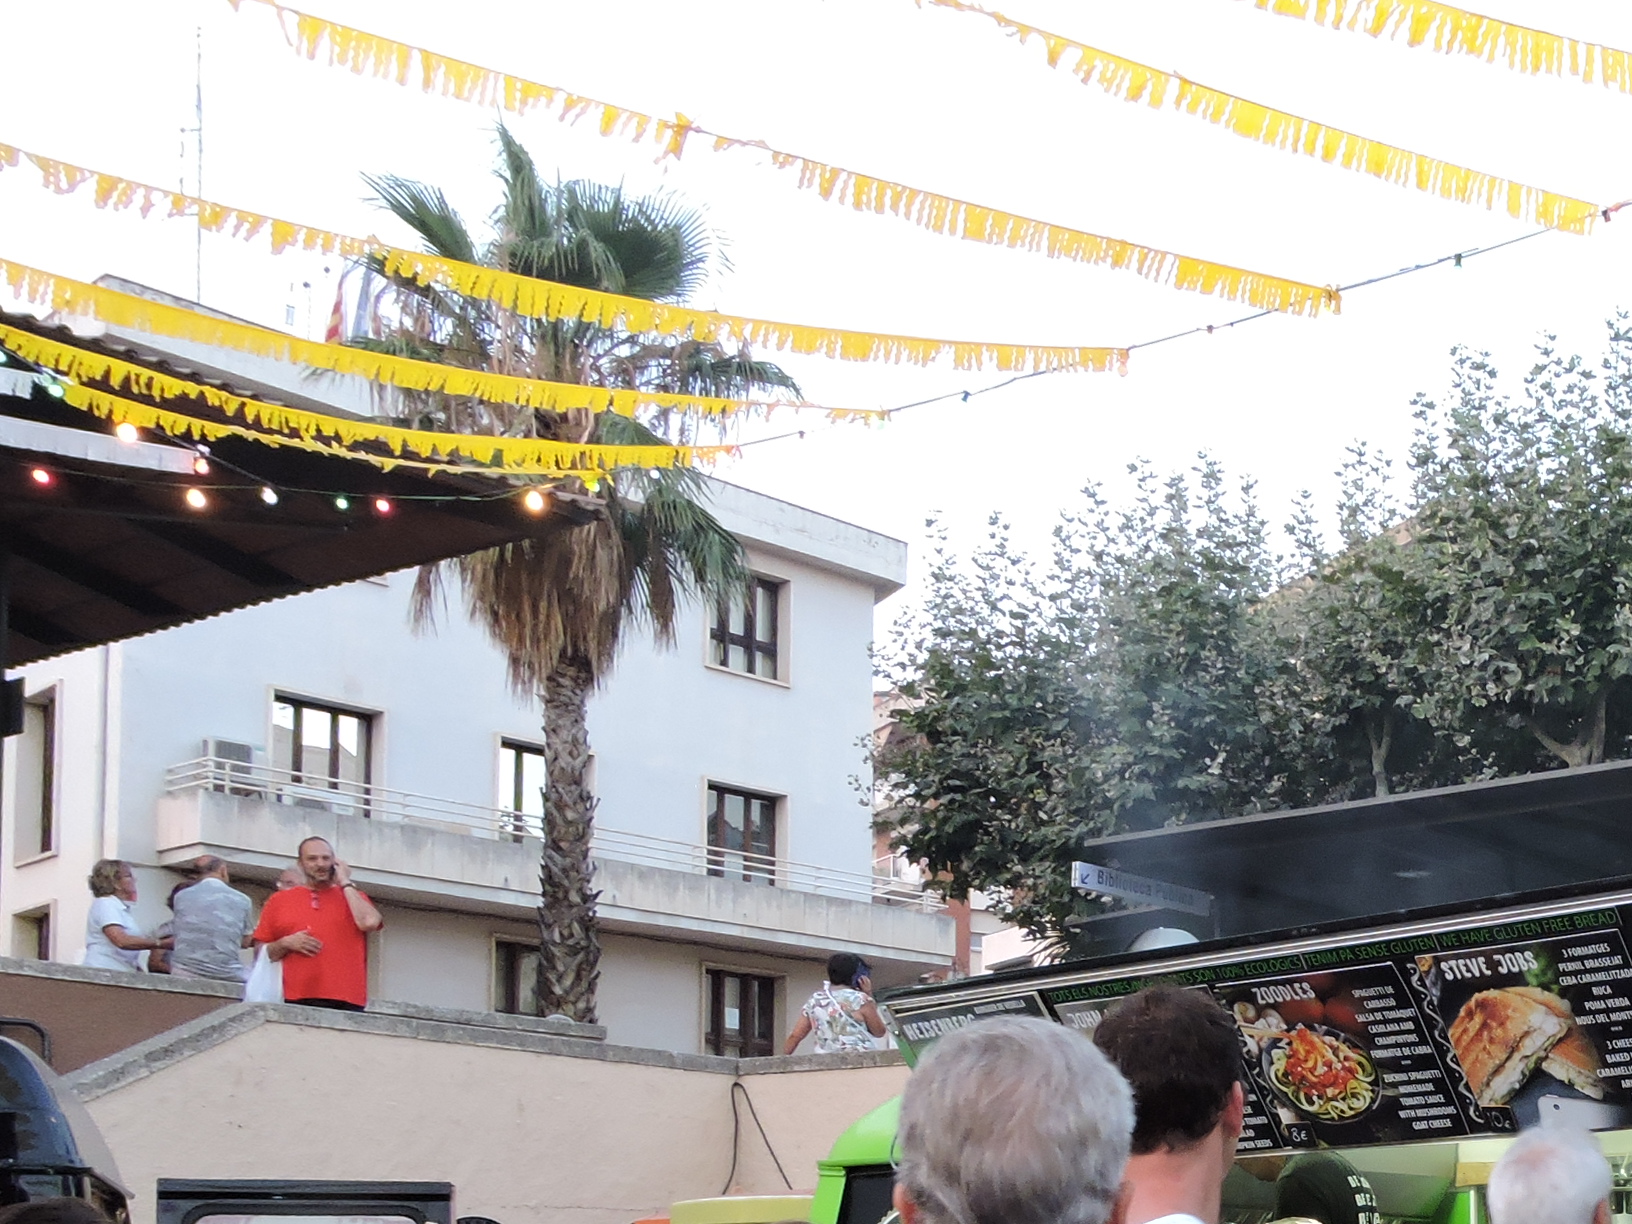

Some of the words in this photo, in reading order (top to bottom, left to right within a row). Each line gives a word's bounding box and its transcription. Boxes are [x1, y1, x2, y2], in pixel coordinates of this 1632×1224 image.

[1440, 934, 1460, 947] WE
[1461, 929, 1493, 944] HAVE
[1493, 922, 1540, 939] GLUTEN
[1543, 917, 1575, 932] FREE
[1574, 911, 1617, 928] BREAD
[1305, 951, 1338, 966] TENIM
[1340, 949, 1355, 961] PA
[1355, 943, 1390, 959] SENSE
[1390, 937, 1435, 953] GLUTEN
[1561, 949, 1568, 958] 3
[1567, 943, 1611, 957] FORMATGES
[1440, 956, 1492, 980] STEVE
[1493, 951, 1538, 975] JOBS
[1584, 955, 1623, 969] BRASSEJAT
[1088, 981, 1130, 997] NOSTRES
[1195, 968, 1215, 982] SON
[1218, 965, 1244, 979] 100%
[1251, 981, 1316, 1005] ZOODLES
[1584, 999, 1606, 1011] POMA
[1605, 997, 1631, 1008] VERDA
[1575, 1016, 1596, 1026] NOUS
[1595, 1014, 1610, 1023] DEL
[1606, 1040, 1612, 1050] 3
[1605, 1052, 1631, 1063] BAKED
[1398, 1109, 1416, 1118] WITH
[1428, 1118, 1452, 1128] CHEESE
[1290, 1127, 1308, 1142] 8€
